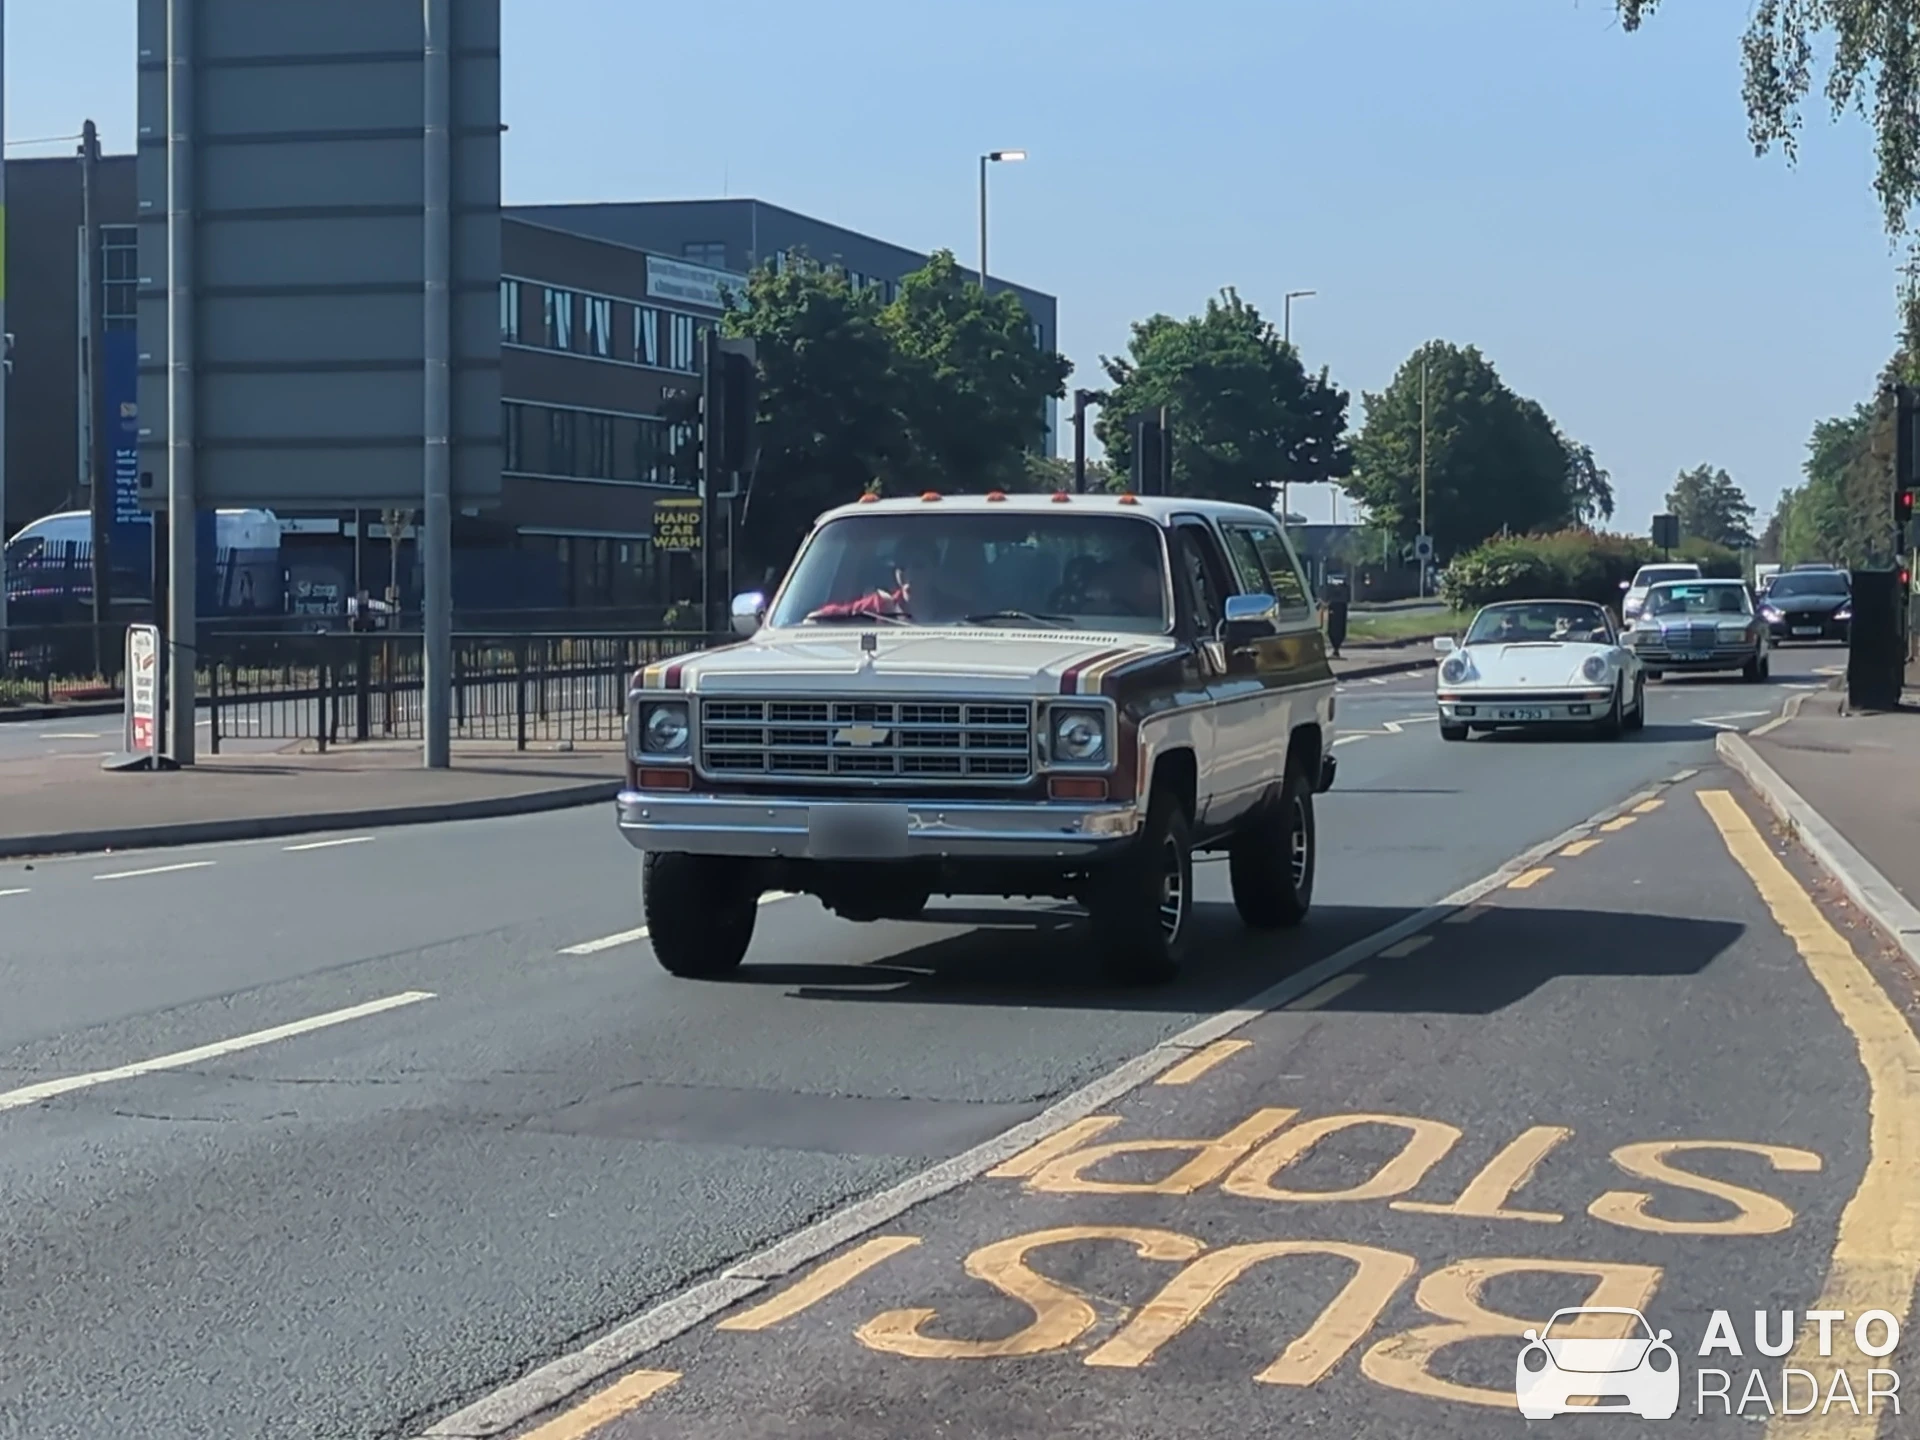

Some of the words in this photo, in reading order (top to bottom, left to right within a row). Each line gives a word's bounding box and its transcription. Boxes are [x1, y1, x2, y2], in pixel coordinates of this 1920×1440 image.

[654, 512, 700, 524] HAND
[660, 524, 693, 536] CAR
[653, 536, 701, 548] WASH
[1026, 1107, 1822, 1235] STOP
[853, 1226, 1662, 1408] BUS
